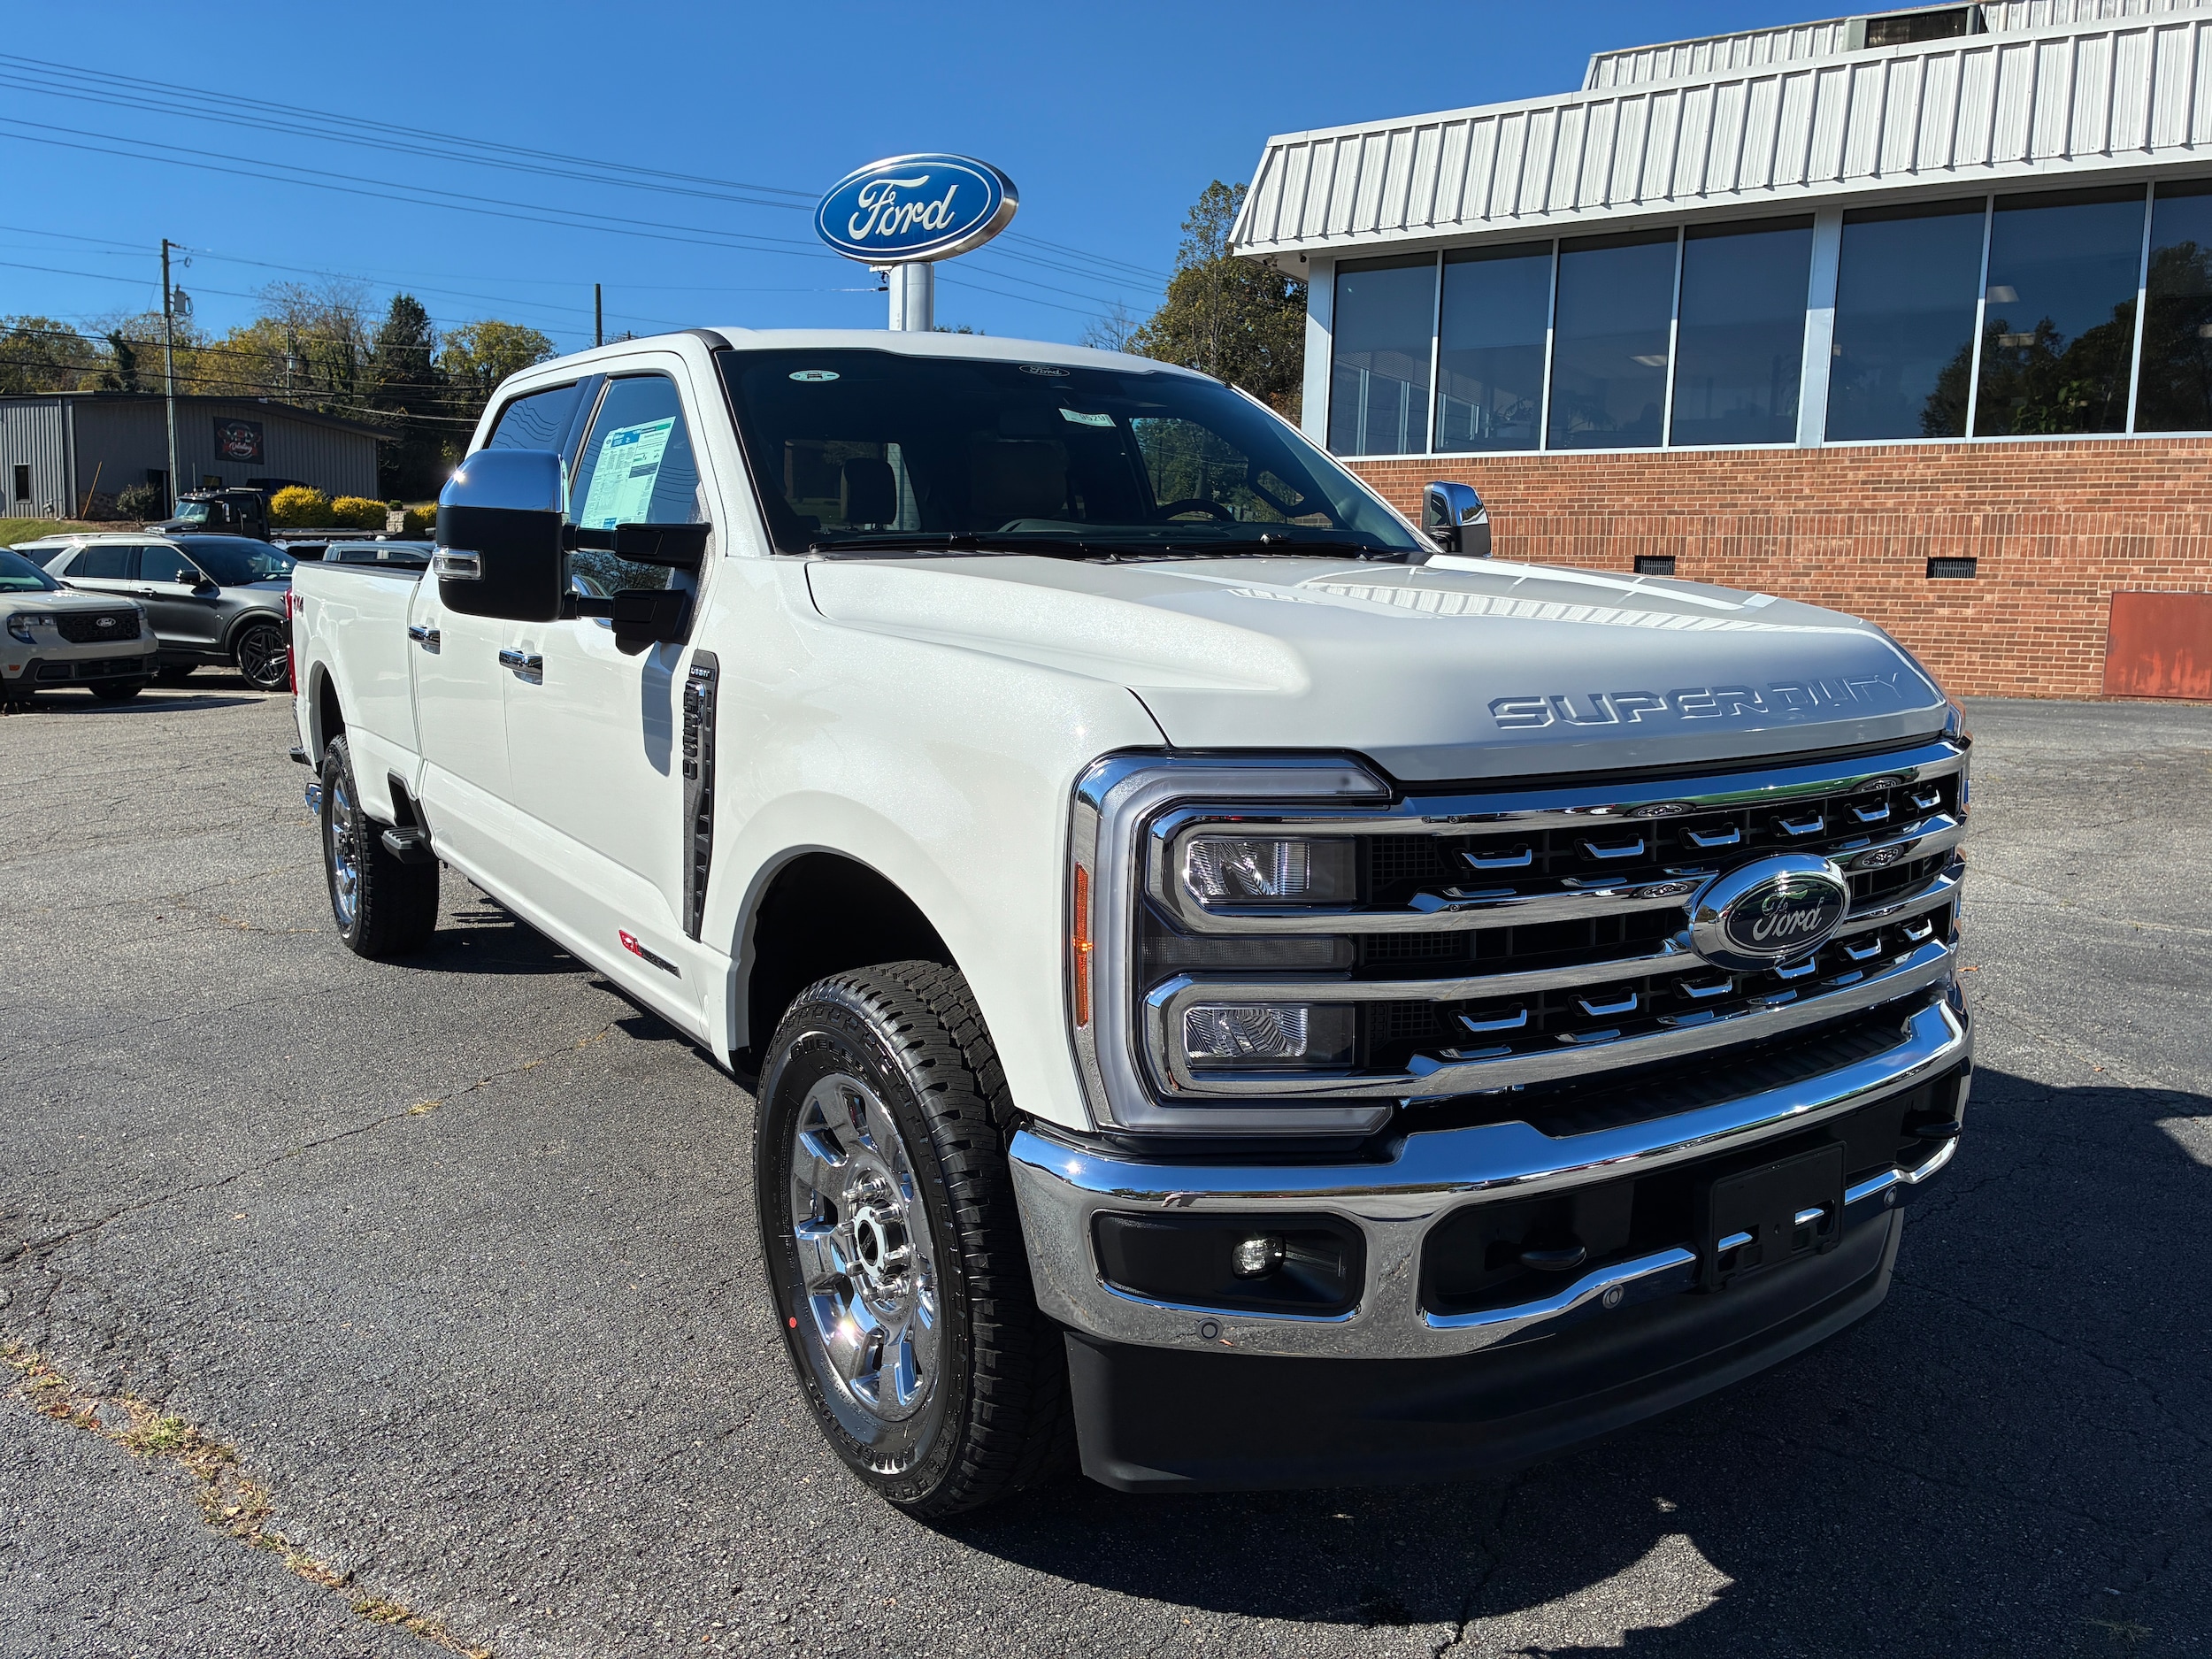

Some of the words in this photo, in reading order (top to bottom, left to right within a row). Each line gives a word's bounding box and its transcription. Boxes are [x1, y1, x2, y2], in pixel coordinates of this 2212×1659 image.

[848, 174, 959, 241] Ford
[1030, 366, 1062, 375] Ford
[1488, 685, 1770, 730] SUPER
[1767, 671, 1902, 712] DUTY
[1752, 888, 1824, 941] Ford
[804, 1376, 916, 1470] BRIDGESTONE
